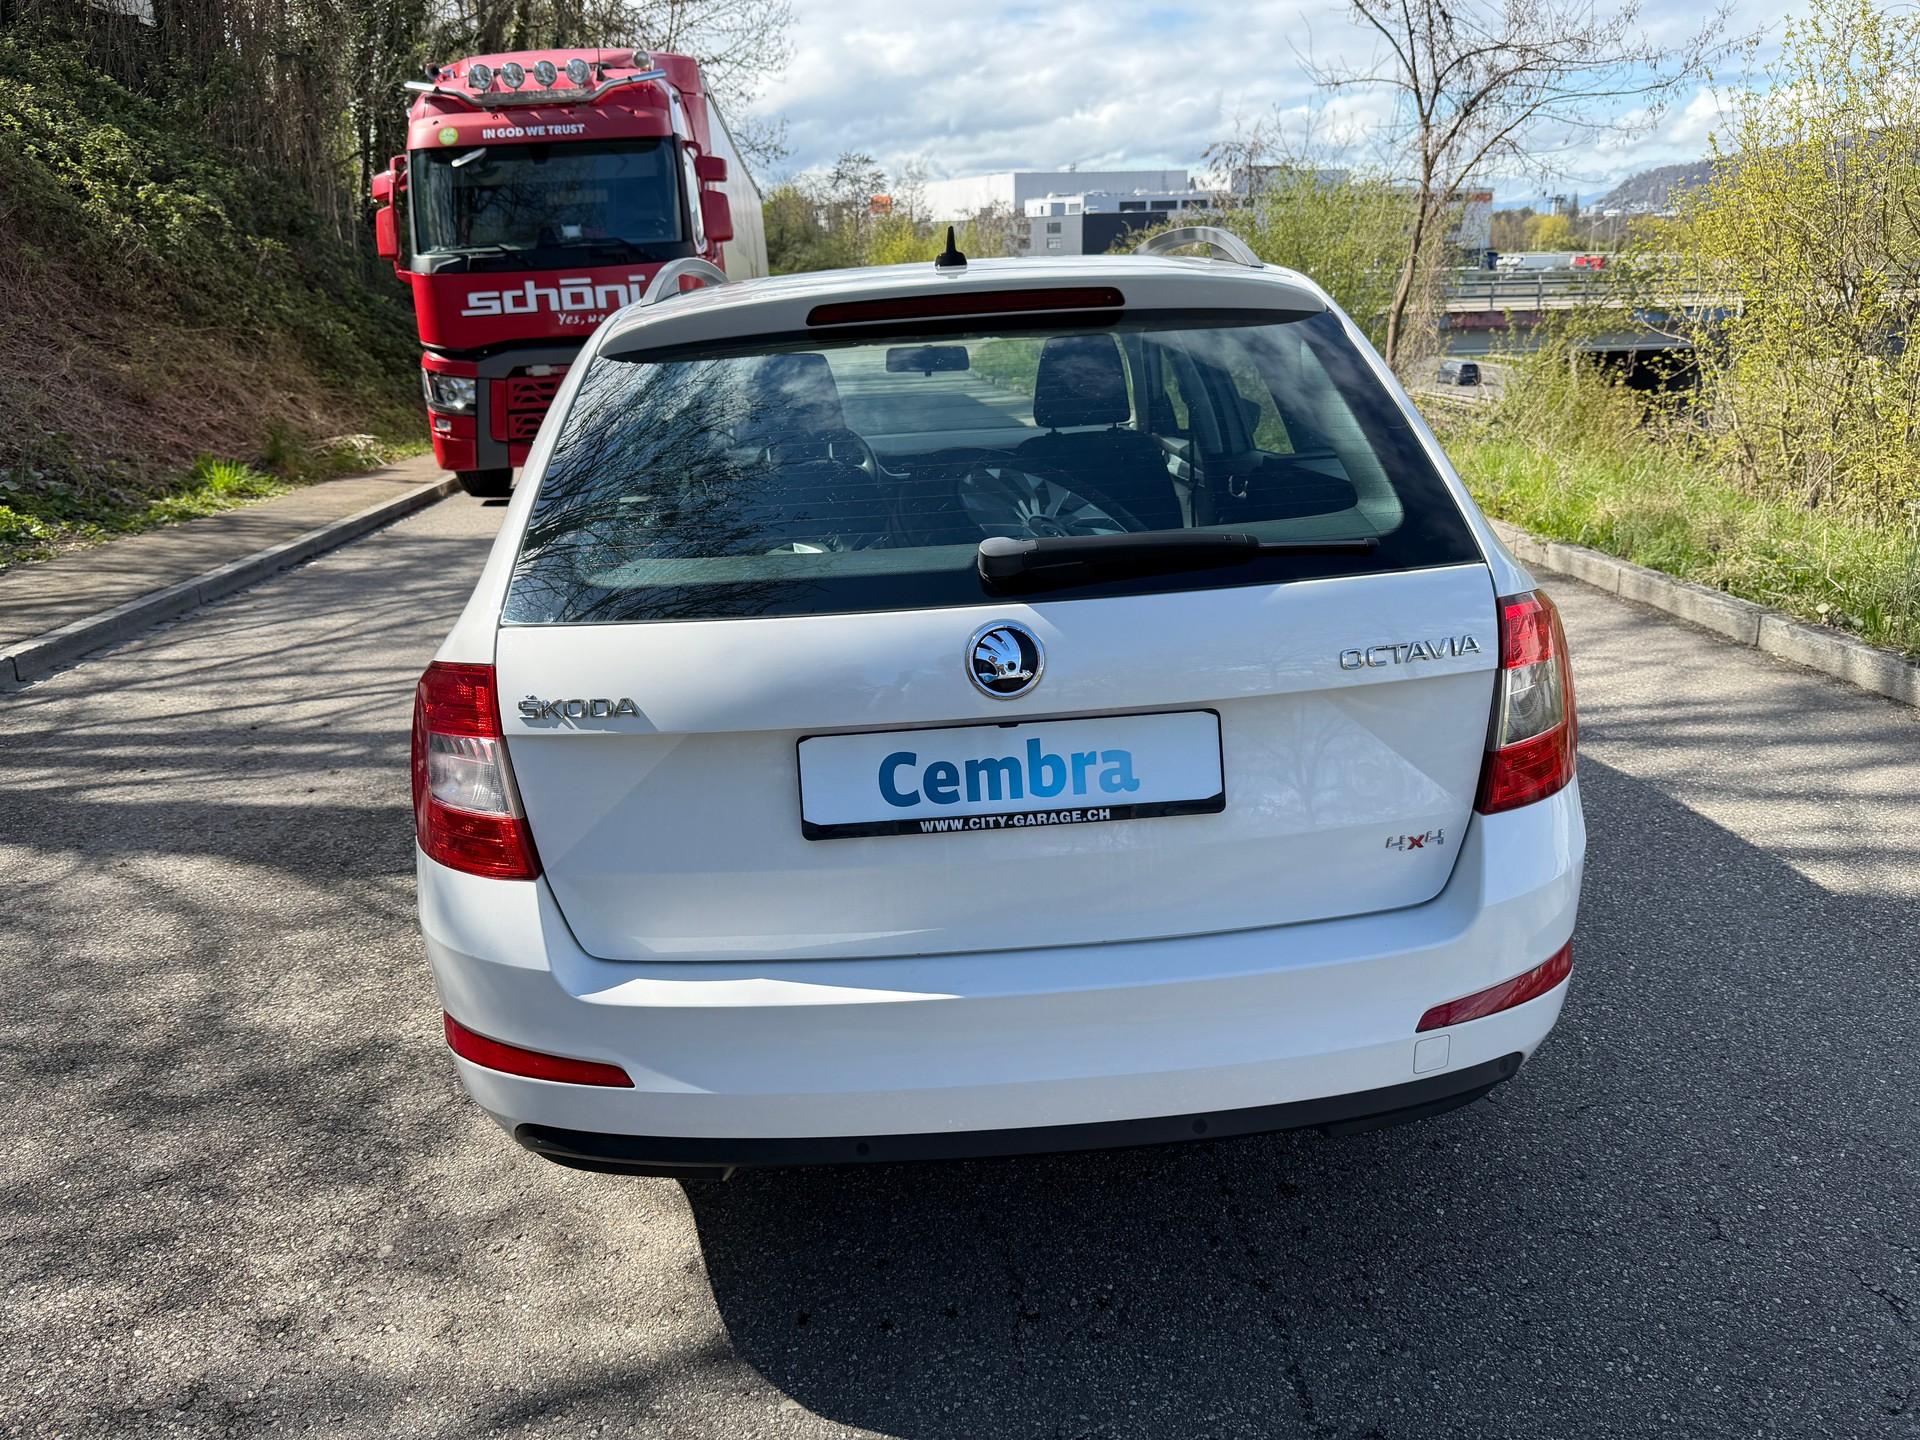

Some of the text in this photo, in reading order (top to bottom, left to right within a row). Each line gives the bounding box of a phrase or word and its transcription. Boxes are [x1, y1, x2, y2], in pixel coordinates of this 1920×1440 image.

[482, 123, 586, 139] IN GOD WE TRUST
[557, 312, 606, 326] Yes, we
[1339, 633, 1482, 670] OCTAVIA
[517, 694, 640, 721] ŠKODA
[877, 737, 1141, 808] Cembra
[920, 808, 1111, 834] WWW.CITY-GARAGE.CH
